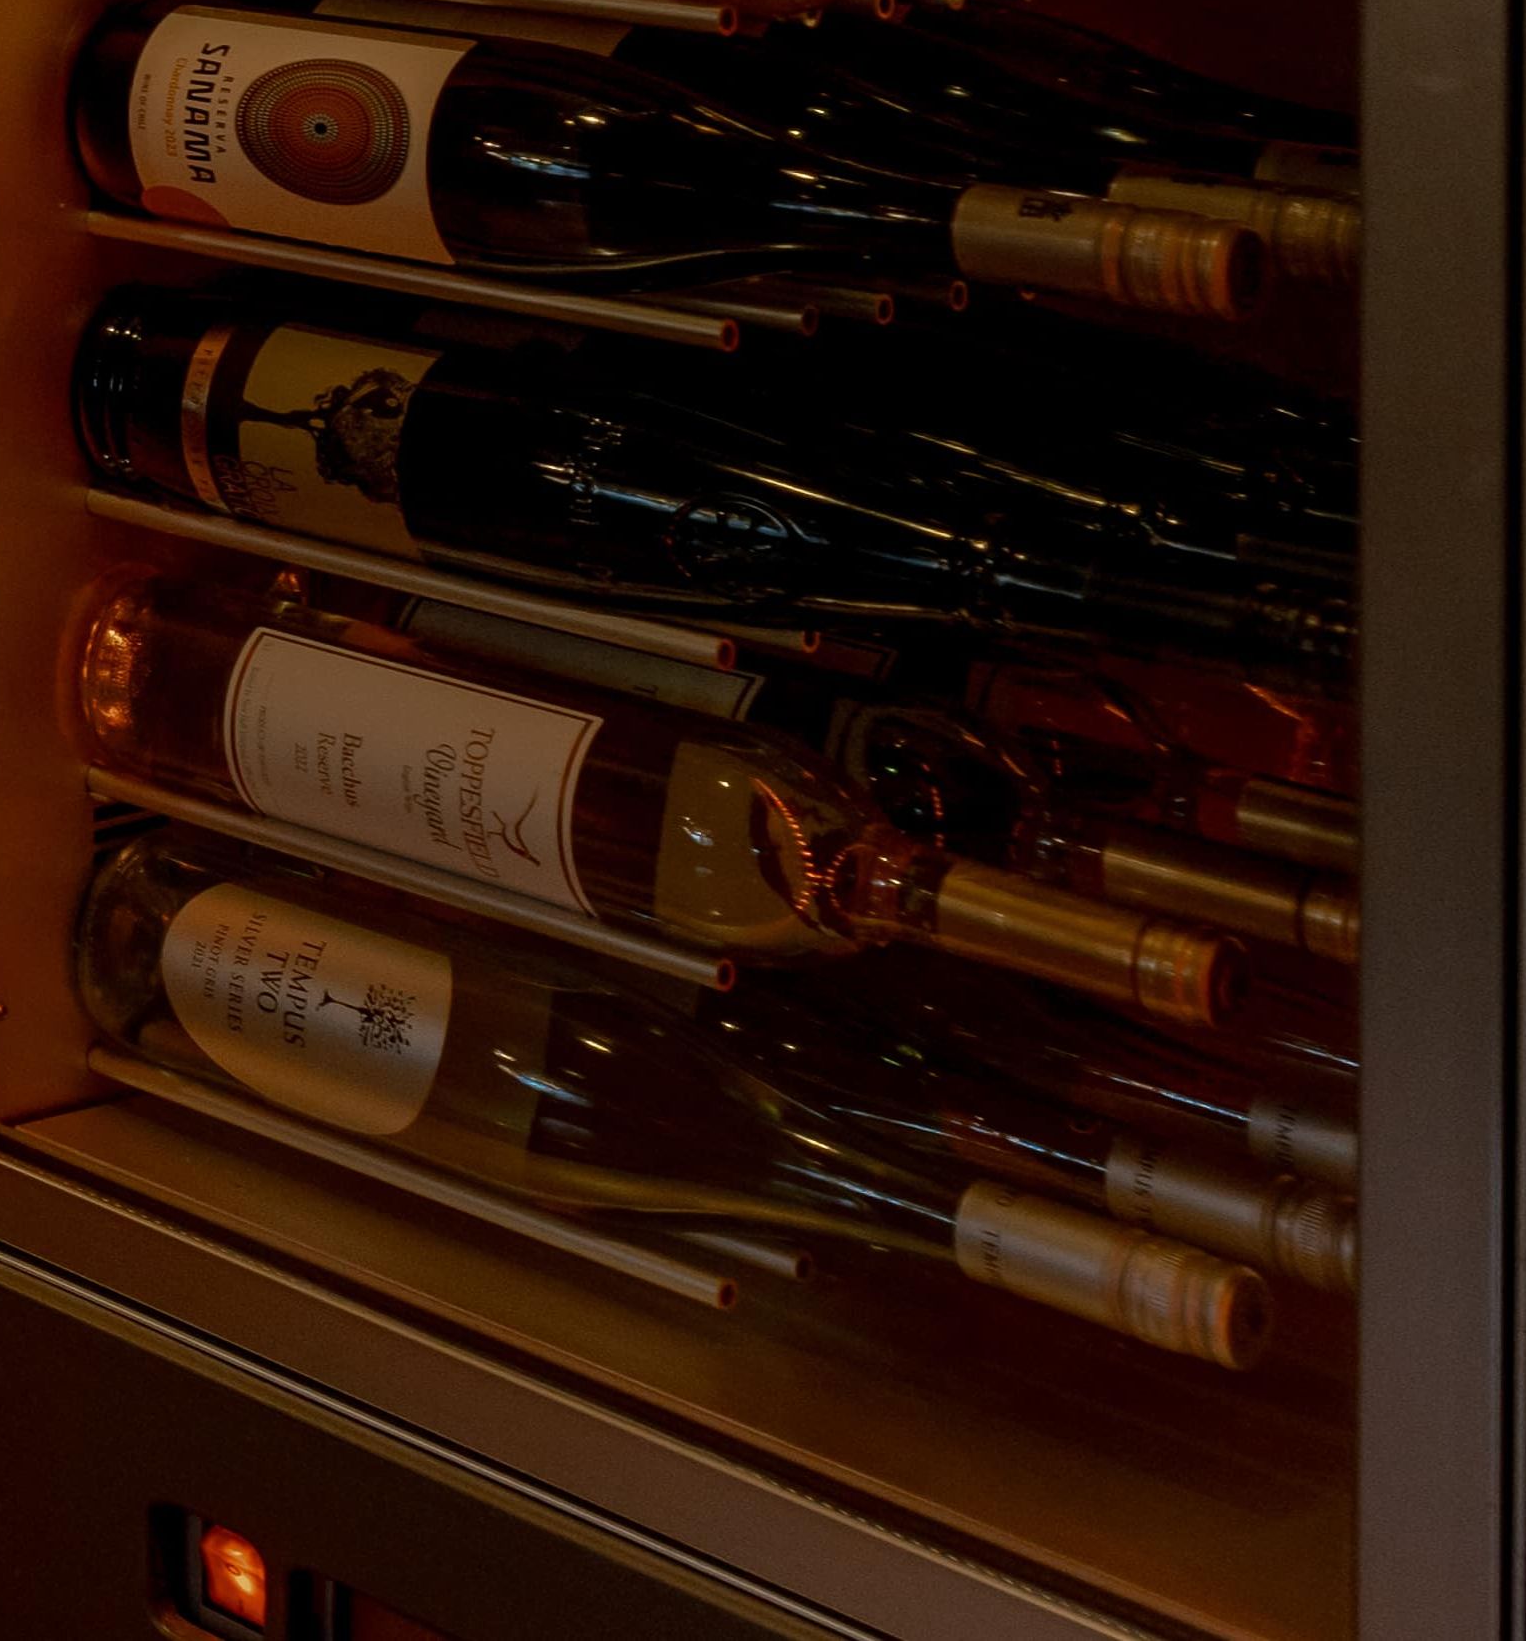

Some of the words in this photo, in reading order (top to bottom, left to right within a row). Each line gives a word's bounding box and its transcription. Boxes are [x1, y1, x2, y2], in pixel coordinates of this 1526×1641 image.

[162, 57, 188, 126] Chardonnay
[183, 42, 231, 184] SANAMA
[215, 75, 234, 154] RESERVA
[317, 731, 338, 796] Reserve
[341, 732, 363, 808] Bacchus
[413, 743, 461, 849] Vineyard
[459, 727, 500, 878] TOPPESFIELD
[206, 923, 229, 962] PINOT
[234, 913, 266, 967] SILVER
[203, 966, 218, 999] GRIS
[227, 972, 245, 1033] SERIES
[257, 951, 290, 1014] TWO
[283, 940, 327, 1048] TEMPUS
